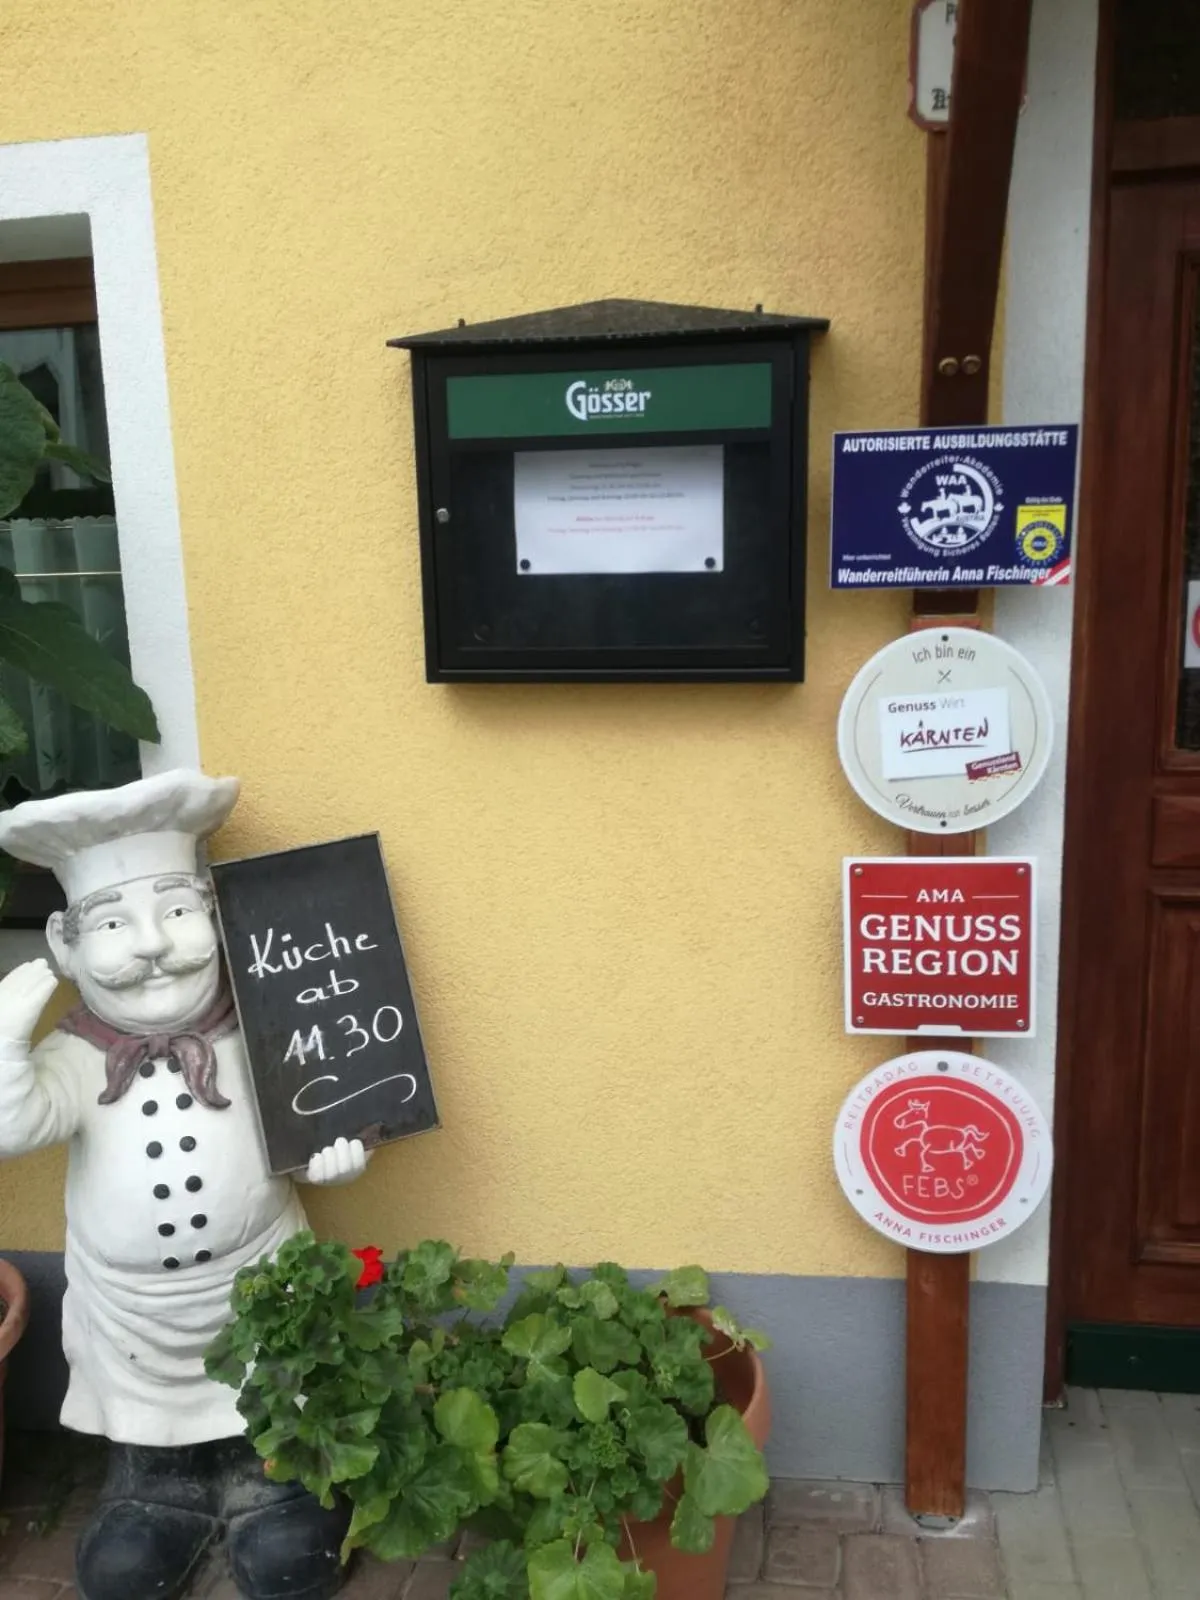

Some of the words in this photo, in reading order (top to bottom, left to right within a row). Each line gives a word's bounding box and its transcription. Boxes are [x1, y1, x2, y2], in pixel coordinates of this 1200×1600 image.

[566, 380, 651, 420] Gösser
[842, 435, 930, 453] AUTORISIERTE
[933, 430, 1068, 450] AUSBILDUNGSSTÄTTE
[935, 474, 967, 486] WAA
[838, 566, 949, 584] Wanderreitführerin
[952, 566, 984, 582] Anna
[986, 563, 1052, 586] Fischinger
[912, 647, 932, 664] Ich
[935, 643, 954, 659] bin
[957, 646, 976, 662] ein
[888, 700, 937, 714] Genuss
[938, 696, 965, 709] Wirt
[916, 888, 965, 903] AMA
[860, 913, 1021, 942] GENUSS
[247, 921, 379, 979] Küche
[862, 948, 1019, 976] REGION
[295, 969, 360, 1005] ab
[862, 991, 1019, 1009] GASTRONOMIE
[282, 1005, 403, 1066] 11.30
[961, 1062, 1041, 1139] BETREUUNG
[873, 1210, 913, 1238] ANNA
[918, 1217, 1008, 1244] FISCHINGER
